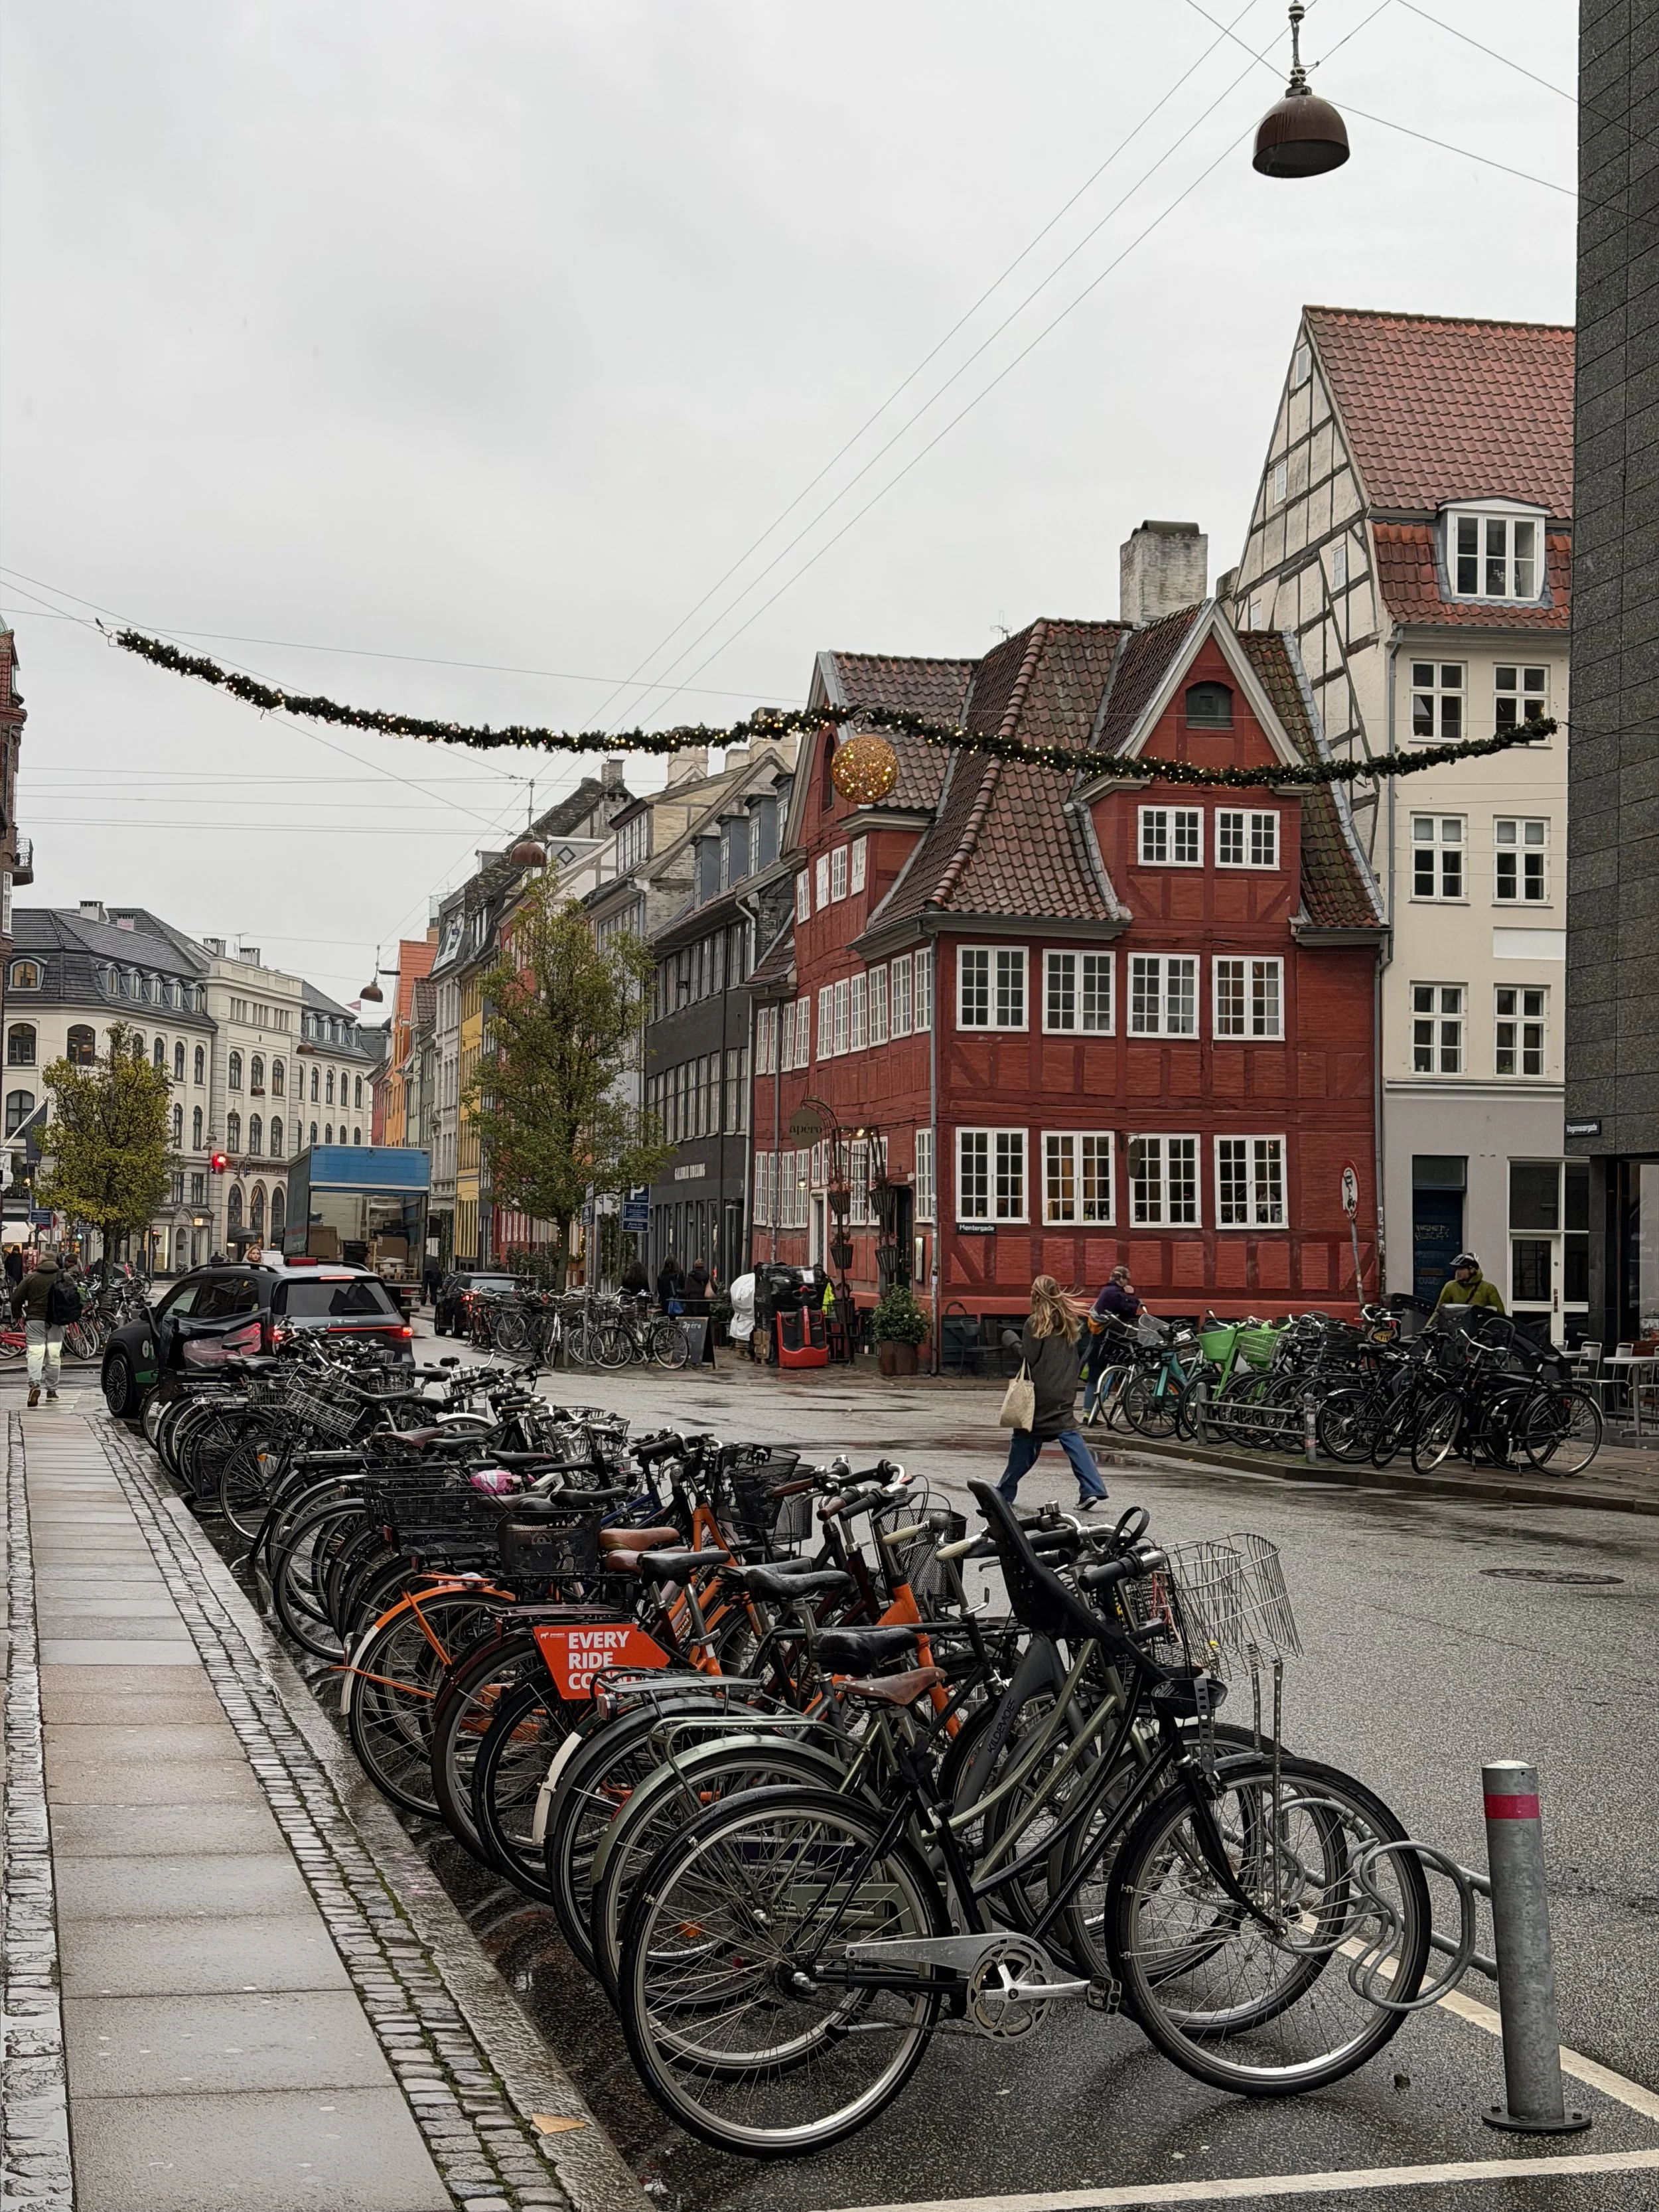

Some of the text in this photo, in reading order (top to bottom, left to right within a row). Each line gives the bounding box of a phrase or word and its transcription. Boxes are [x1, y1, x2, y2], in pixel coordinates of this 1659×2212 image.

[790, 1122, 822, 1136] apéro
[569, 1631, 630, 1649] EVERY
[569, 1651, 614, 1670] RIDE
